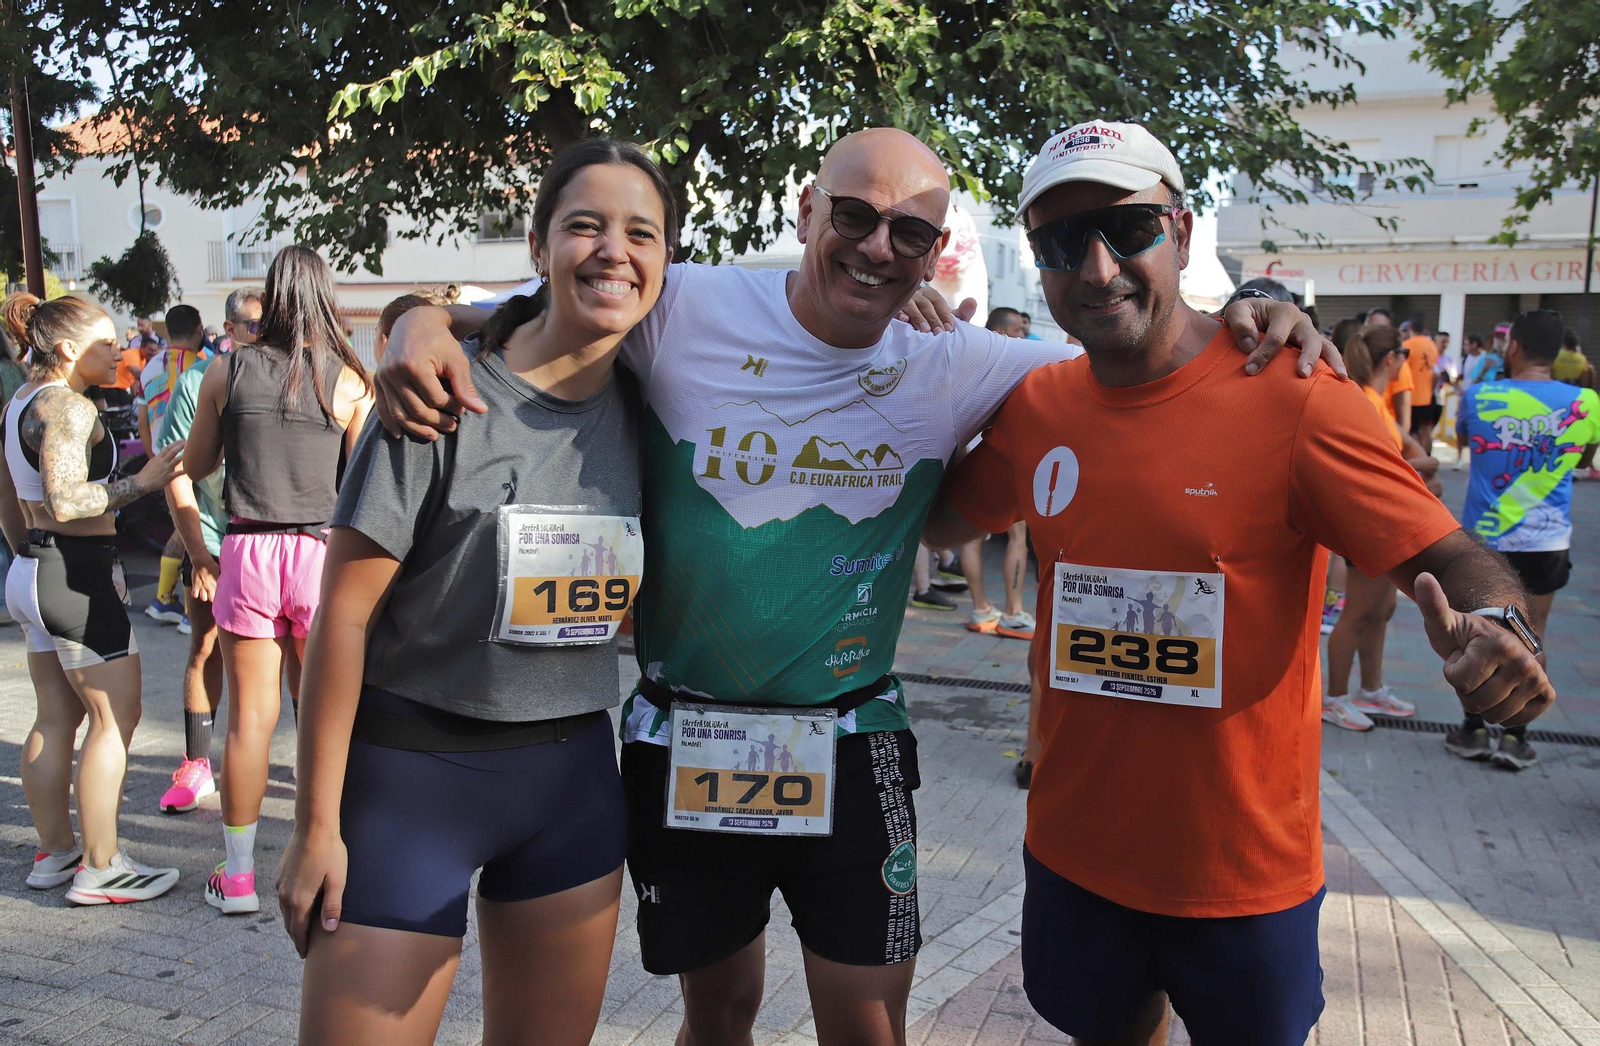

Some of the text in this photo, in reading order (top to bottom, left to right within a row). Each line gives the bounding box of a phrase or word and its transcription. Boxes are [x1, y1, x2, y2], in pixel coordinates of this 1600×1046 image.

[1048, 125, 1124, 155] HARVARD
[1071, 136, 1091, 146] 1636
[1052, 143, 1116, 161] UNIVERSITY
[1338, 257, 1521, 284] CERVECERÍA
[1493, 407, 1568, 450] RIDE
[699, 426, 777, 486] 10
[810, 473, 873, 488] EURAFRICA
[877, 473, 903, 487] TRAIL
[1184, 487, 1218, 496] sputnik
[519, 533, 533, 544] POR
[551, 533, 580, 545] SONRISA
[533, 579, 630, 613] 169
[1062, 580, 1124, 599] POR UNA SONRISA
[1069, 629, 1199, 675] 238
[1095, 668, 1168, 684] MONTERO FUENTES, ESTHER
[1116, 683, 1143, 694] SEPTIEMBRE
[1190, 689, 1200, 698] XL
[681, 727, 747, 741] POR UNA SONRISA
[694, 771, 813, 806] 170
[705, 805, 734, 813] HERNÁNDEZ
[734, 818, 761, 827] SEPTIEMBRE
[883, 811, 897, 849] URAFRICA
